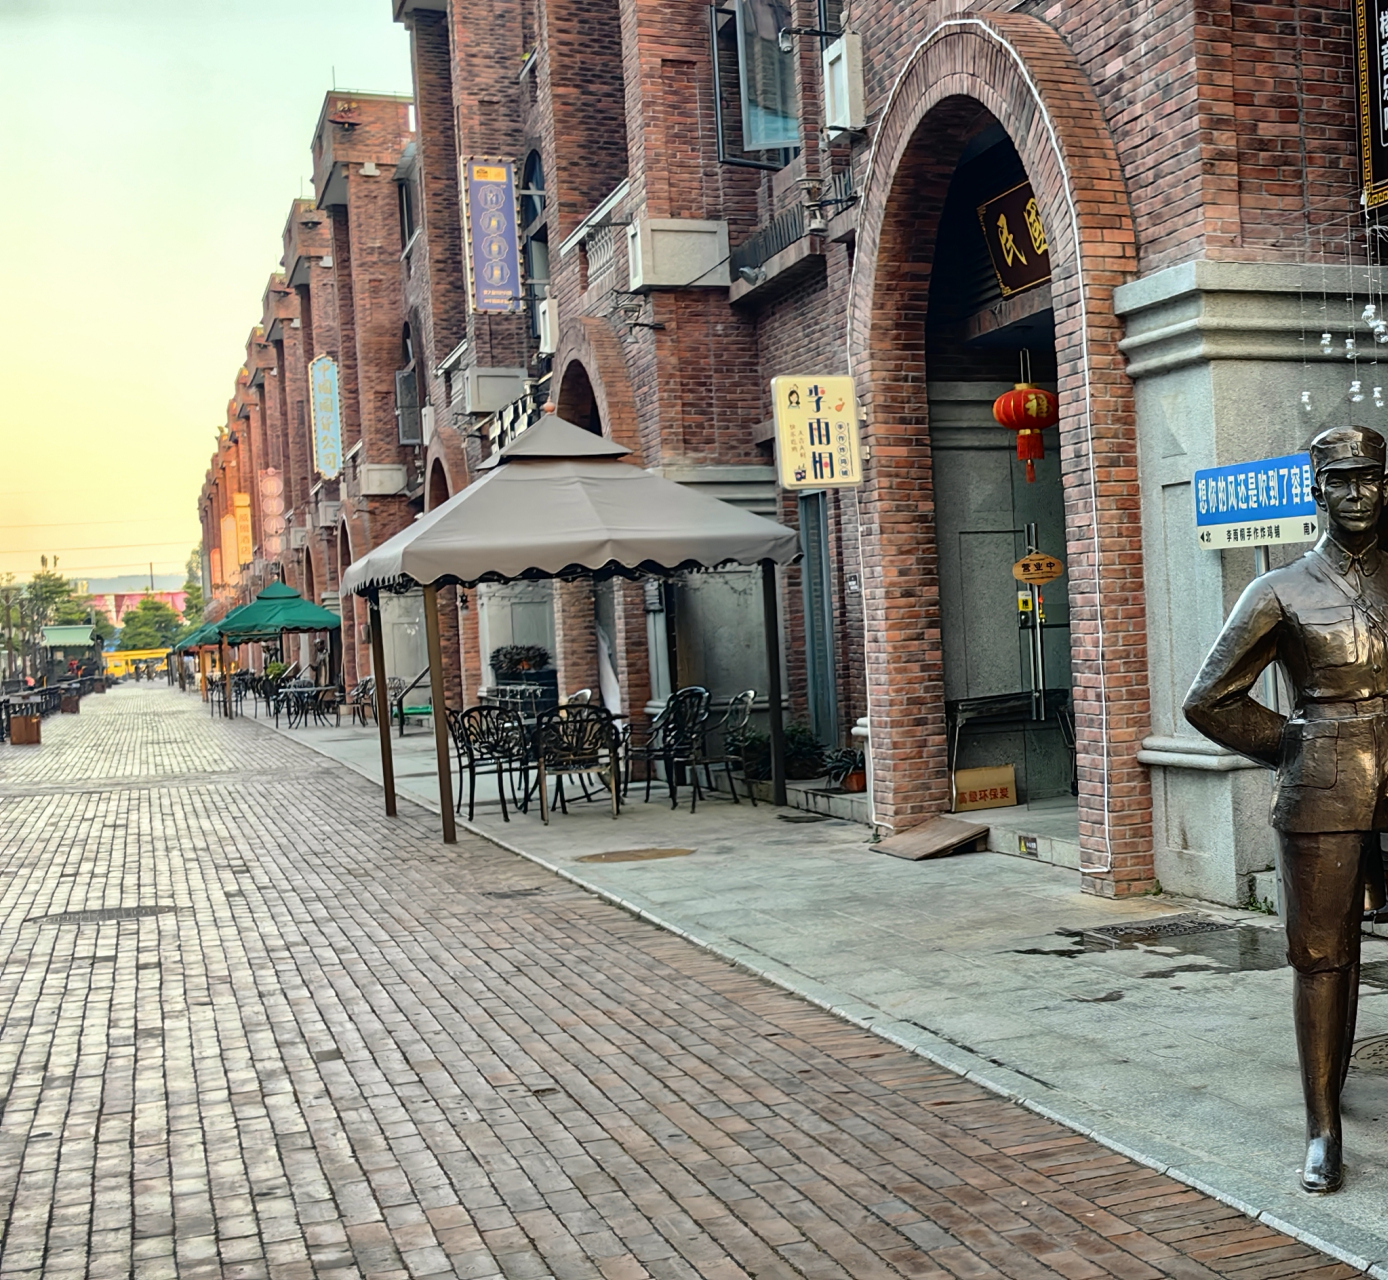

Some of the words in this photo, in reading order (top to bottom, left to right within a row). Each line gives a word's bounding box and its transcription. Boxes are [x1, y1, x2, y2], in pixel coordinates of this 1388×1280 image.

[1198, 465, 1313, 514] 想你的风还是吹到了容县
[1021, 561, 1056, 573] 营业中
